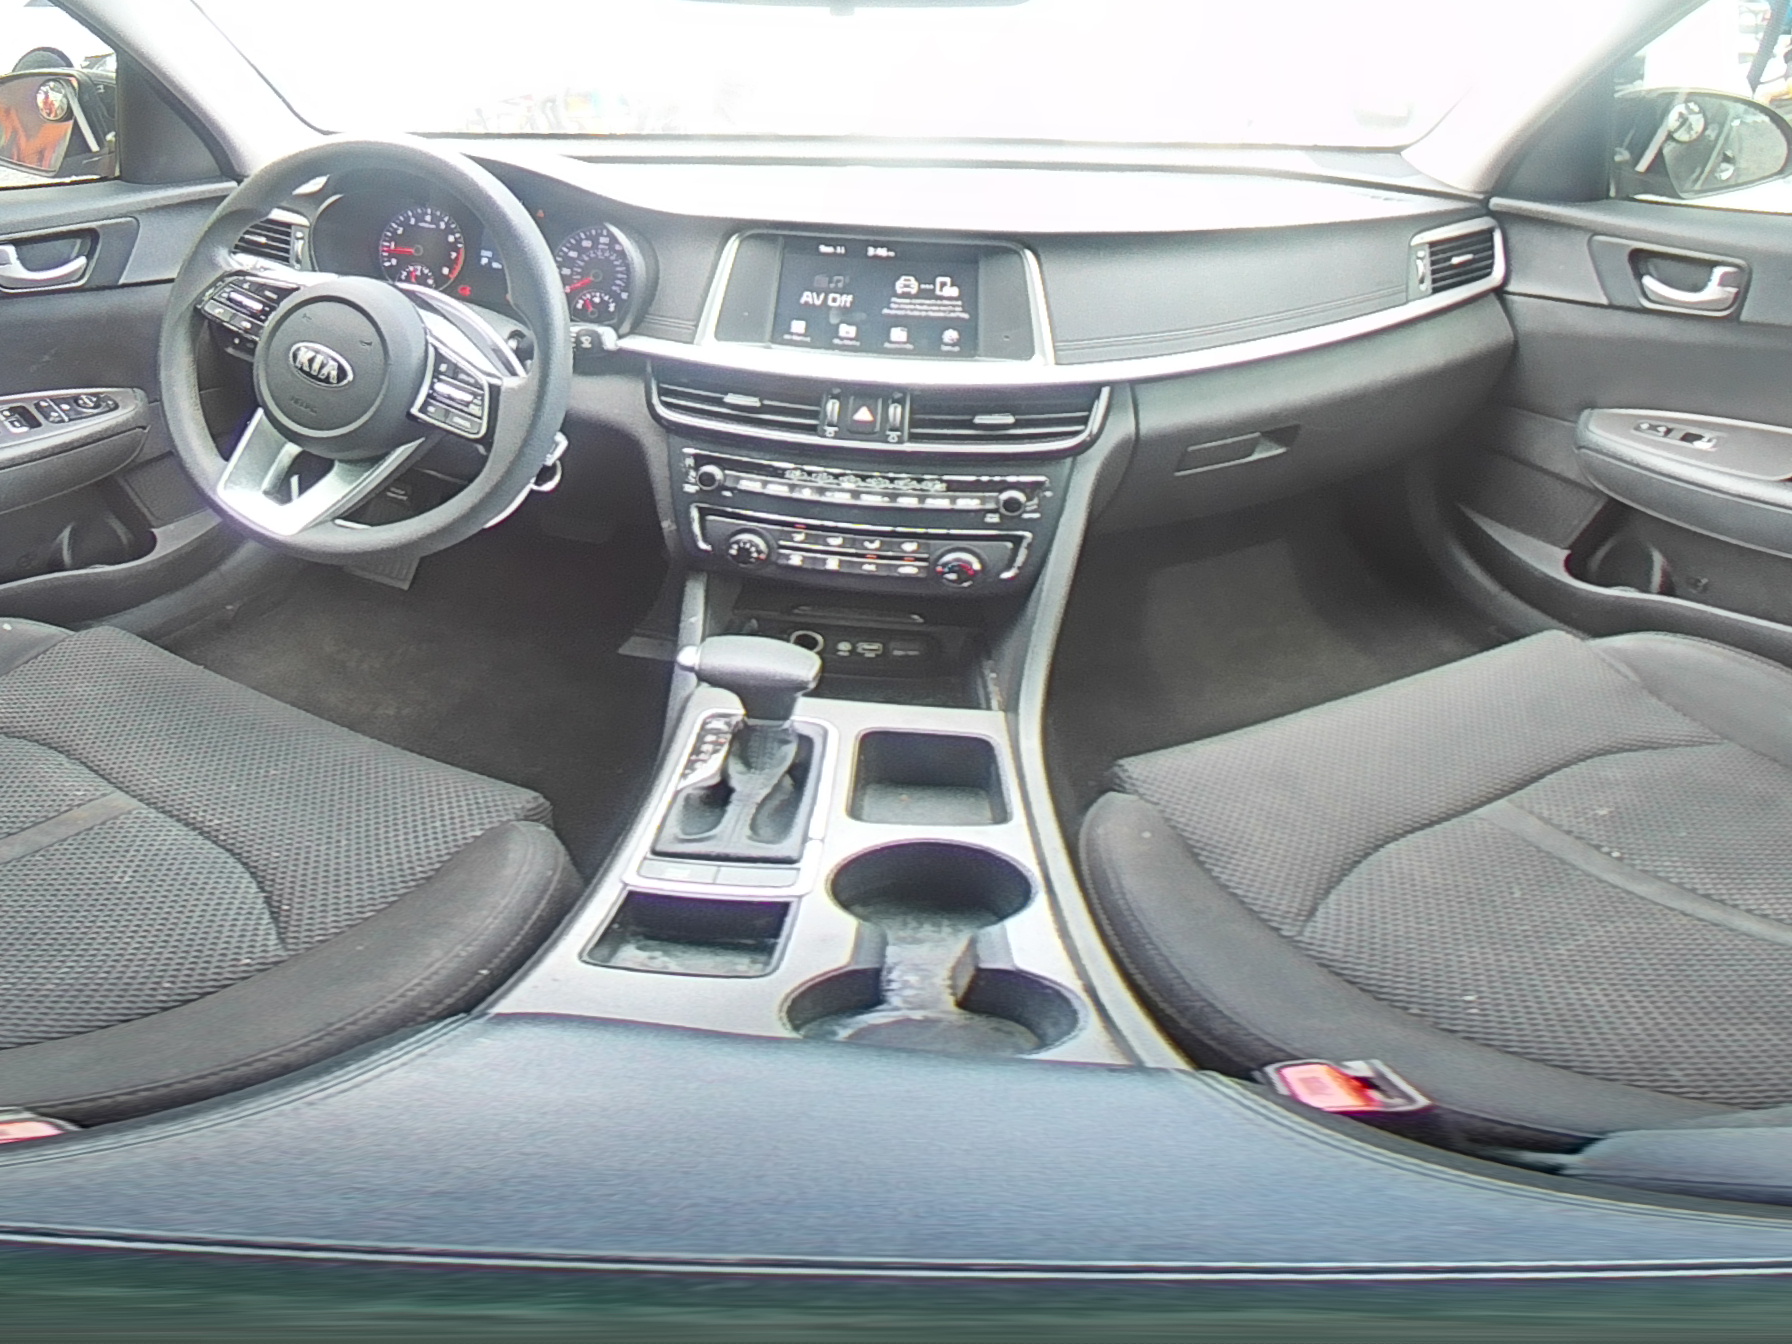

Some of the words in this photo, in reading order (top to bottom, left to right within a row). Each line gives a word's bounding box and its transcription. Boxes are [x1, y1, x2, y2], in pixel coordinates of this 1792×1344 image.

[799, 291, 825, 306] AV
[827, 292, 854, 308] Off
[295, 346, 338, 384] KIA
